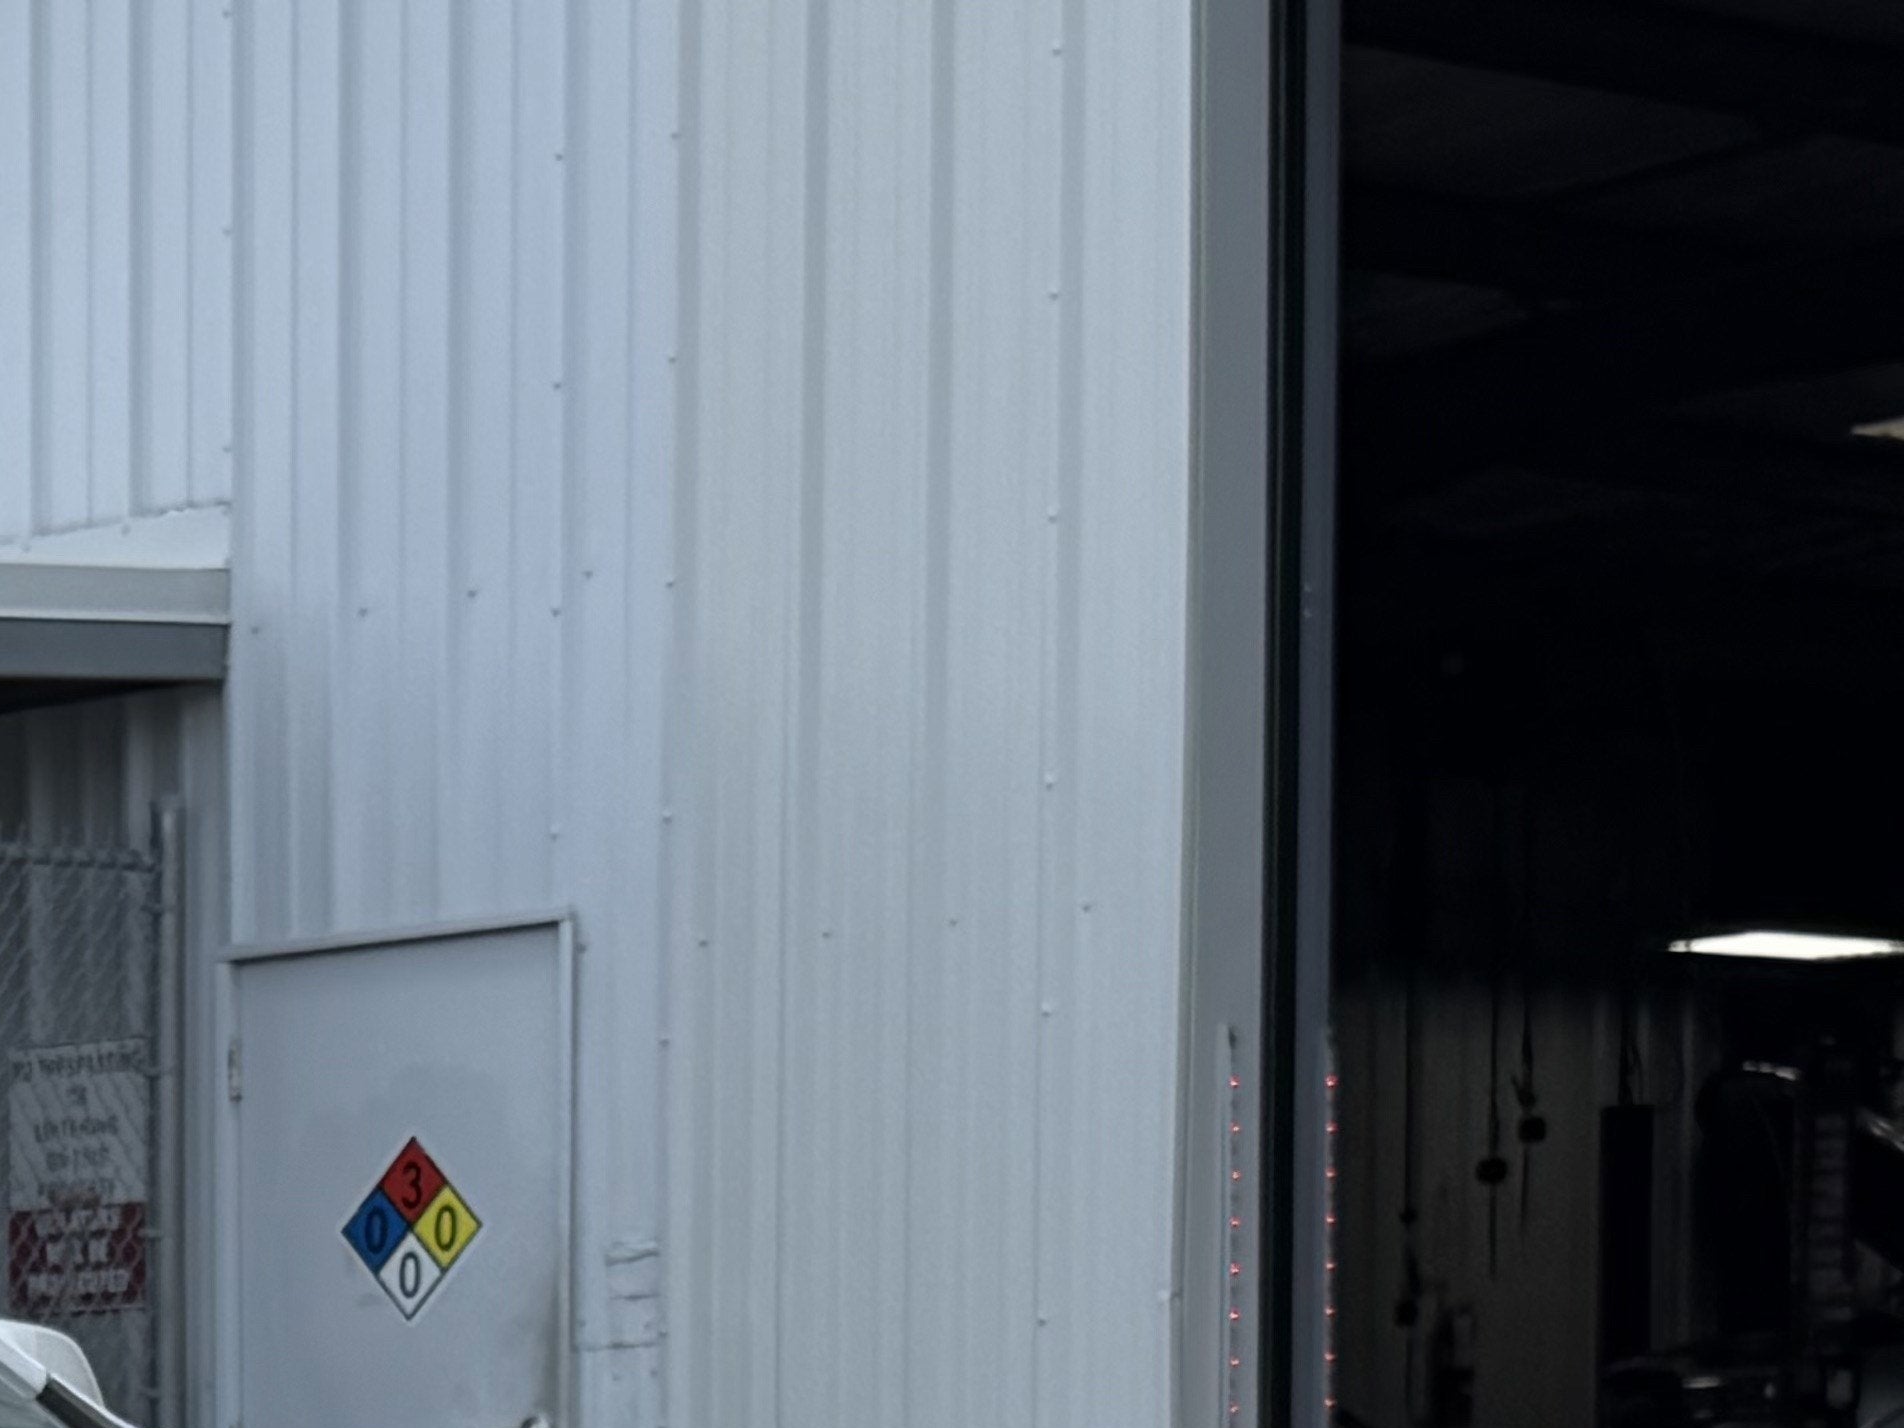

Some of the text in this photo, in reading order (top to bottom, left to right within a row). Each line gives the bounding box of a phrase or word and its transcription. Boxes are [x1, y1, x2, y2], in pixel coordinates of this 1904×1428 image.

[402, 1161, 423, 1209] 3
[365, 1204, 457, 1255] 0 0
[399, 1251, 422, 1299] 0
